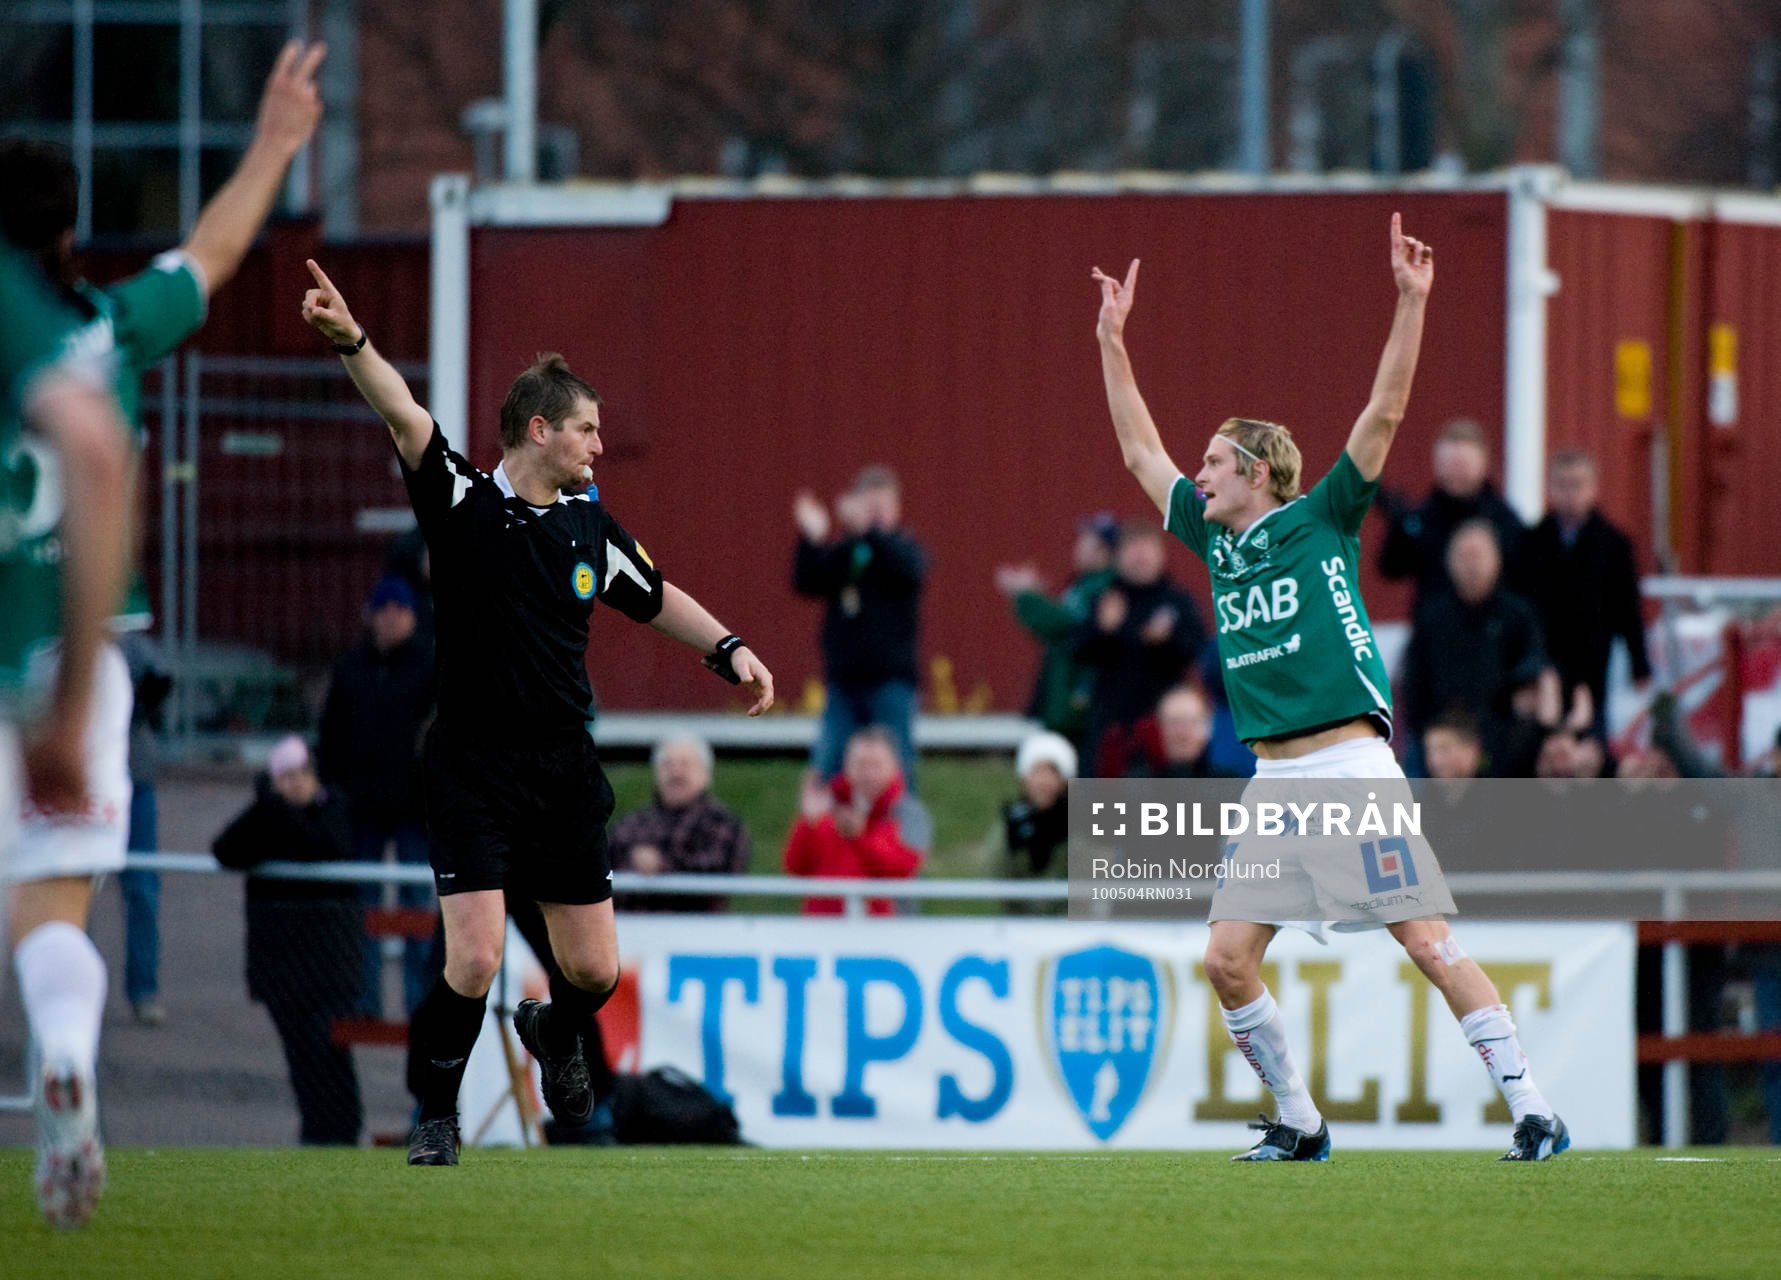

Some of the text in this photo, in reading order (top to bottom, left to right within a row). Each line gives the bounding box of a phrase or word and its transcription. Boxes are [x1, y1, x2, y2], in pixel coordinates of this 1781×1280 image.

[1217, 577, 1299, 634] SSAB
[1321, 556, 1373, 662] Scandic
[1060, 976, 1152, 1013] TIPS
[668, 956, 1014, 1122] TIPS
[1059, 1014, 1153, 1053] ELIT
